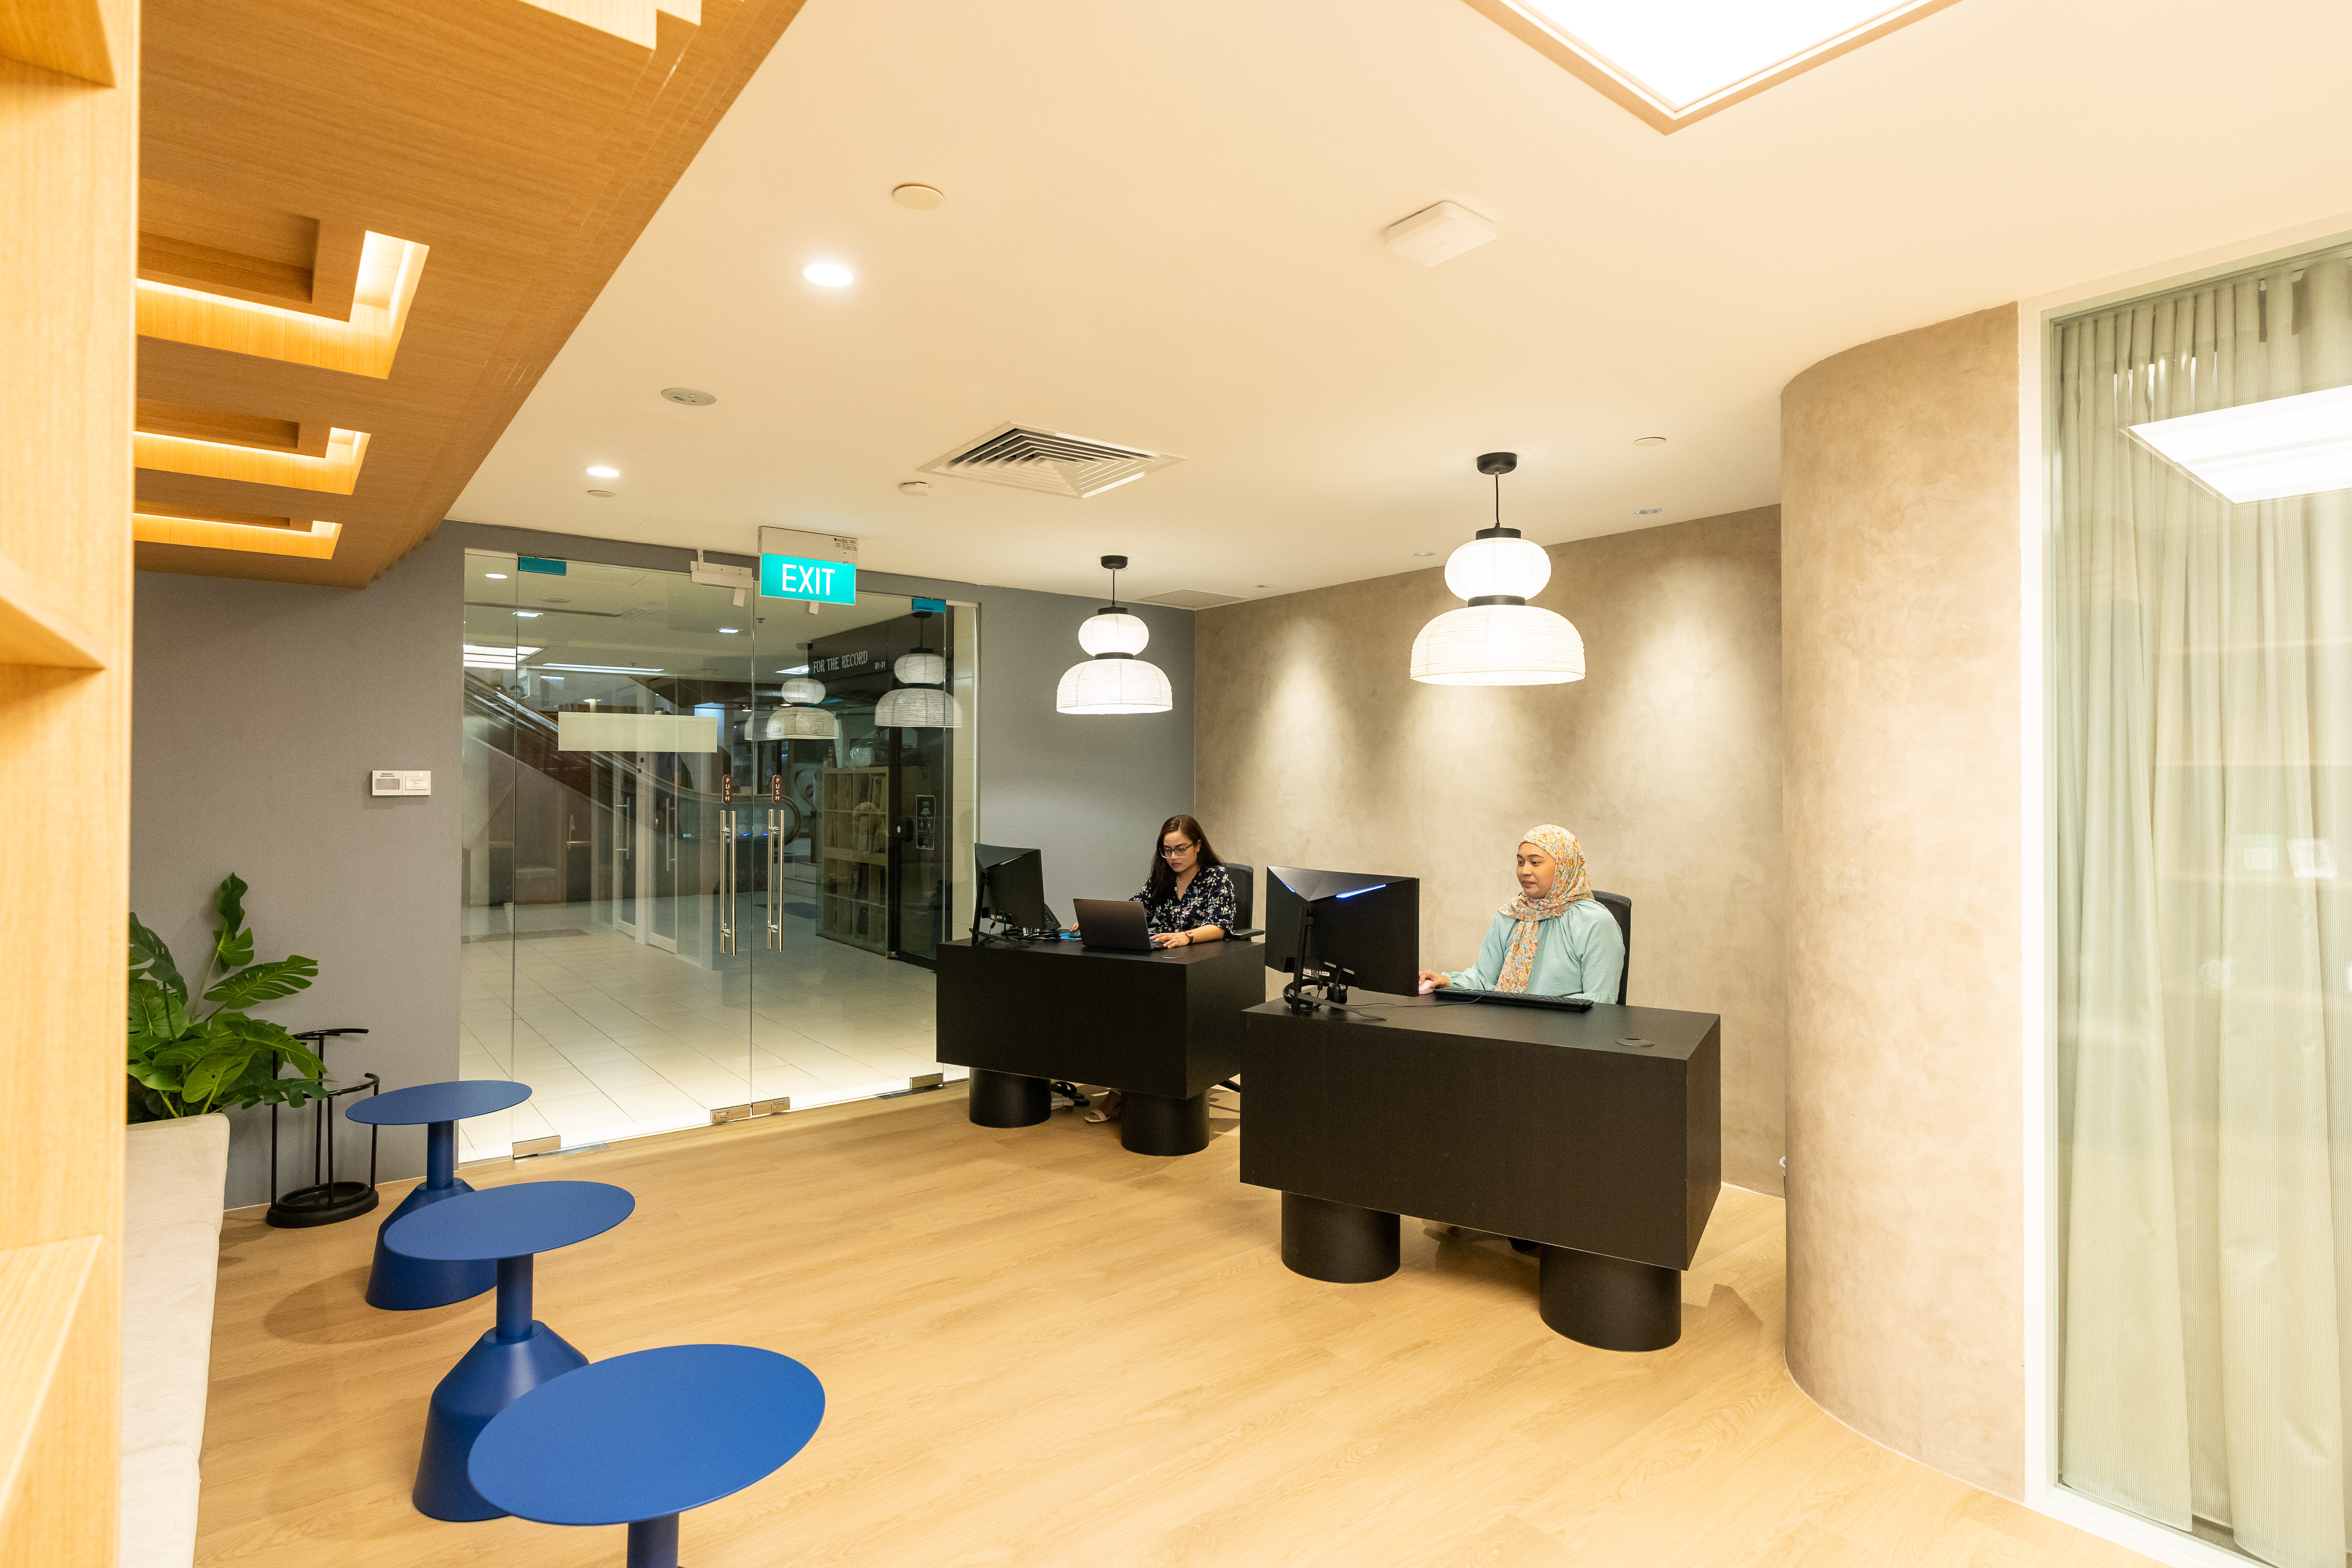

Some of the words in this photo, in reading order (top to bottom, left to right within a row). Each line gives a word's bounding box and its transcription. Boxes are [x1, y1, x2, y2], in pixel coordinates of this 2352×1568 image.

[782, 564, 835, 595] EXIT
[813, 660, 825, 673] FOR
[826, 657, 839, 671] THE
[842, 651, 867, 668] RECORD
